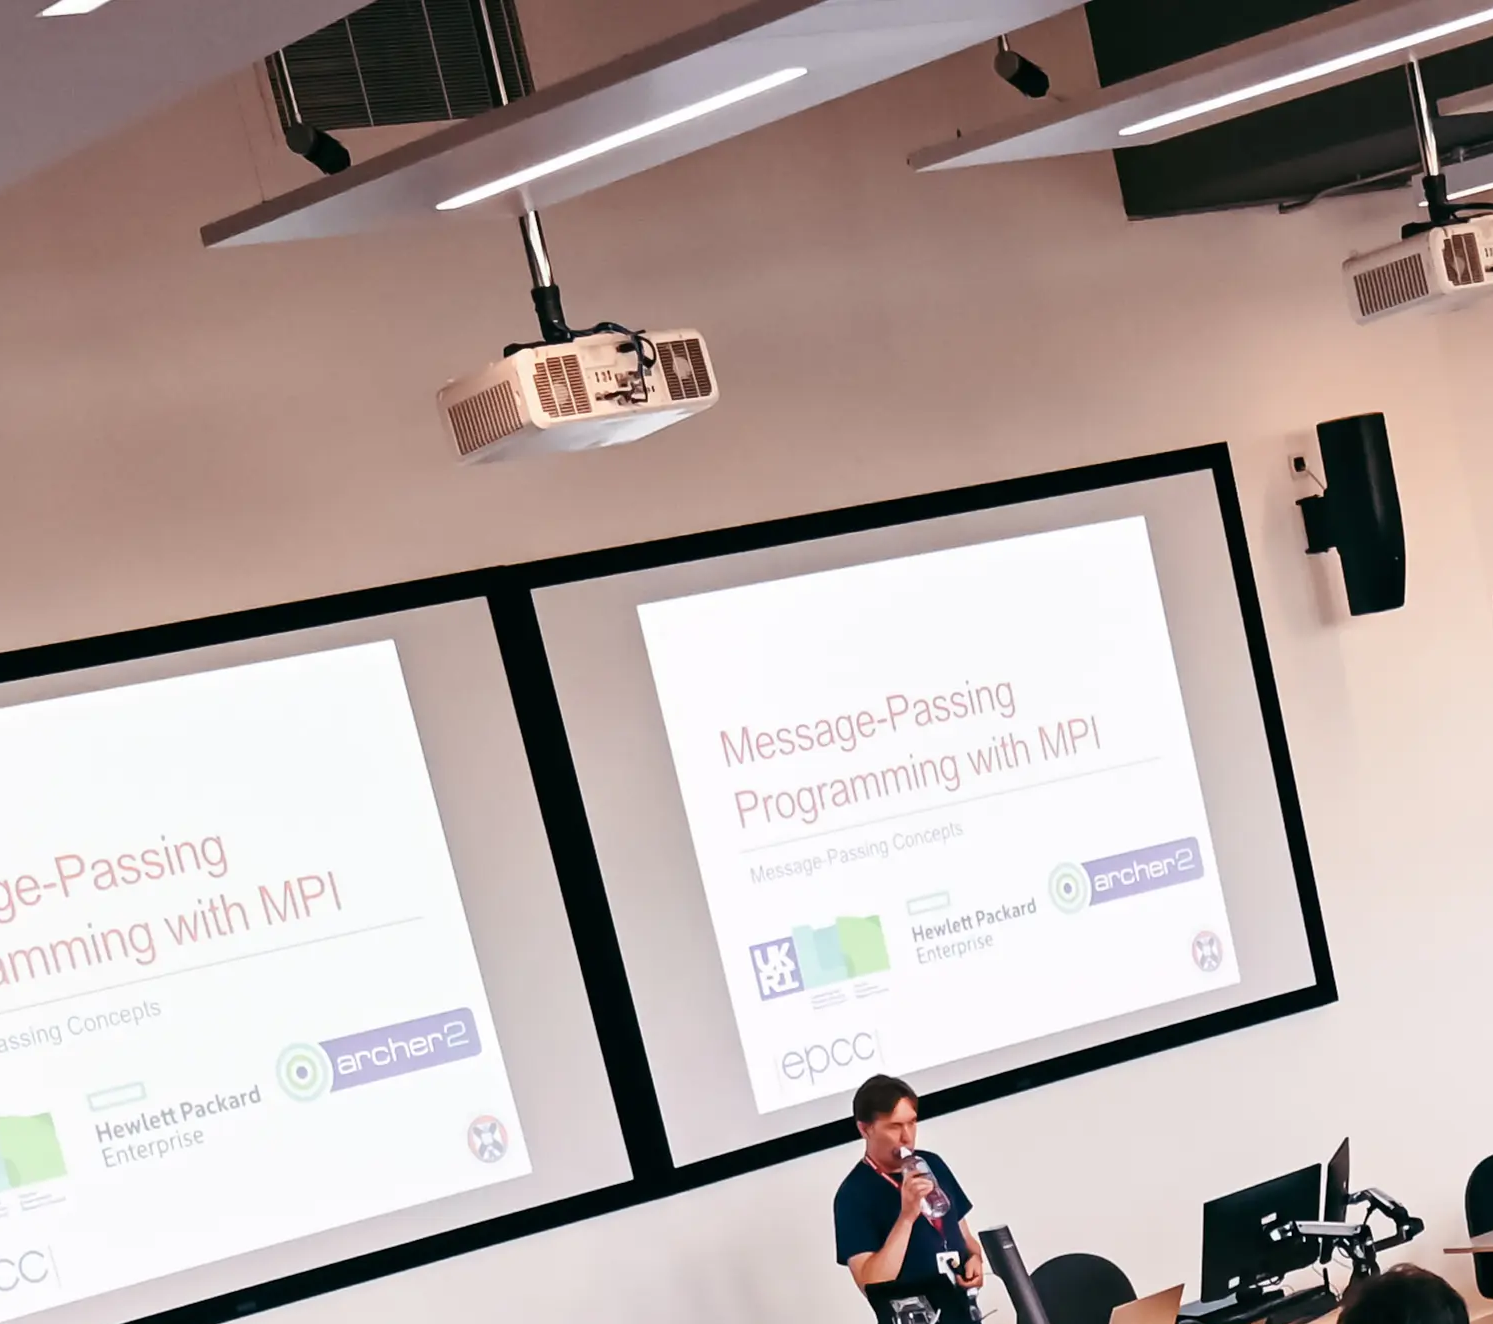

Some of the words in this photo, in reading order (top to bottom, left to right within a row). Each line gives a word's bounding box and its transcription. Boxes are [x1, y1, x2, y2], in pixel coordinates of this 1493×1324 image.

[720, 681, 1015, 767] Message-Passing
[735, 754, 960, 828] Programming
[967, 733, 1030, 775] with
[1038, 716, 1100, 760] MPI
[750, 841, 888, 883] Message-Passing
[893, 823, 963, 850] Concepts
[165, 894, 249, 945] with
[258, 871, 341, 925] MPI
[912, 916, 973, 942] Hewlett
[976, 898, 1036, 926] Packard
[916, 935, 993, 964] Enterprise
[67, 1001, 161, 1035] Concepts
[782, 1032, 874, 1085] epcc
[96, 1108, 177, 1144] Hewlett
[180, 1085, 261, 1121] Packard
[102, 1130, 203, 1167] Enterprise
